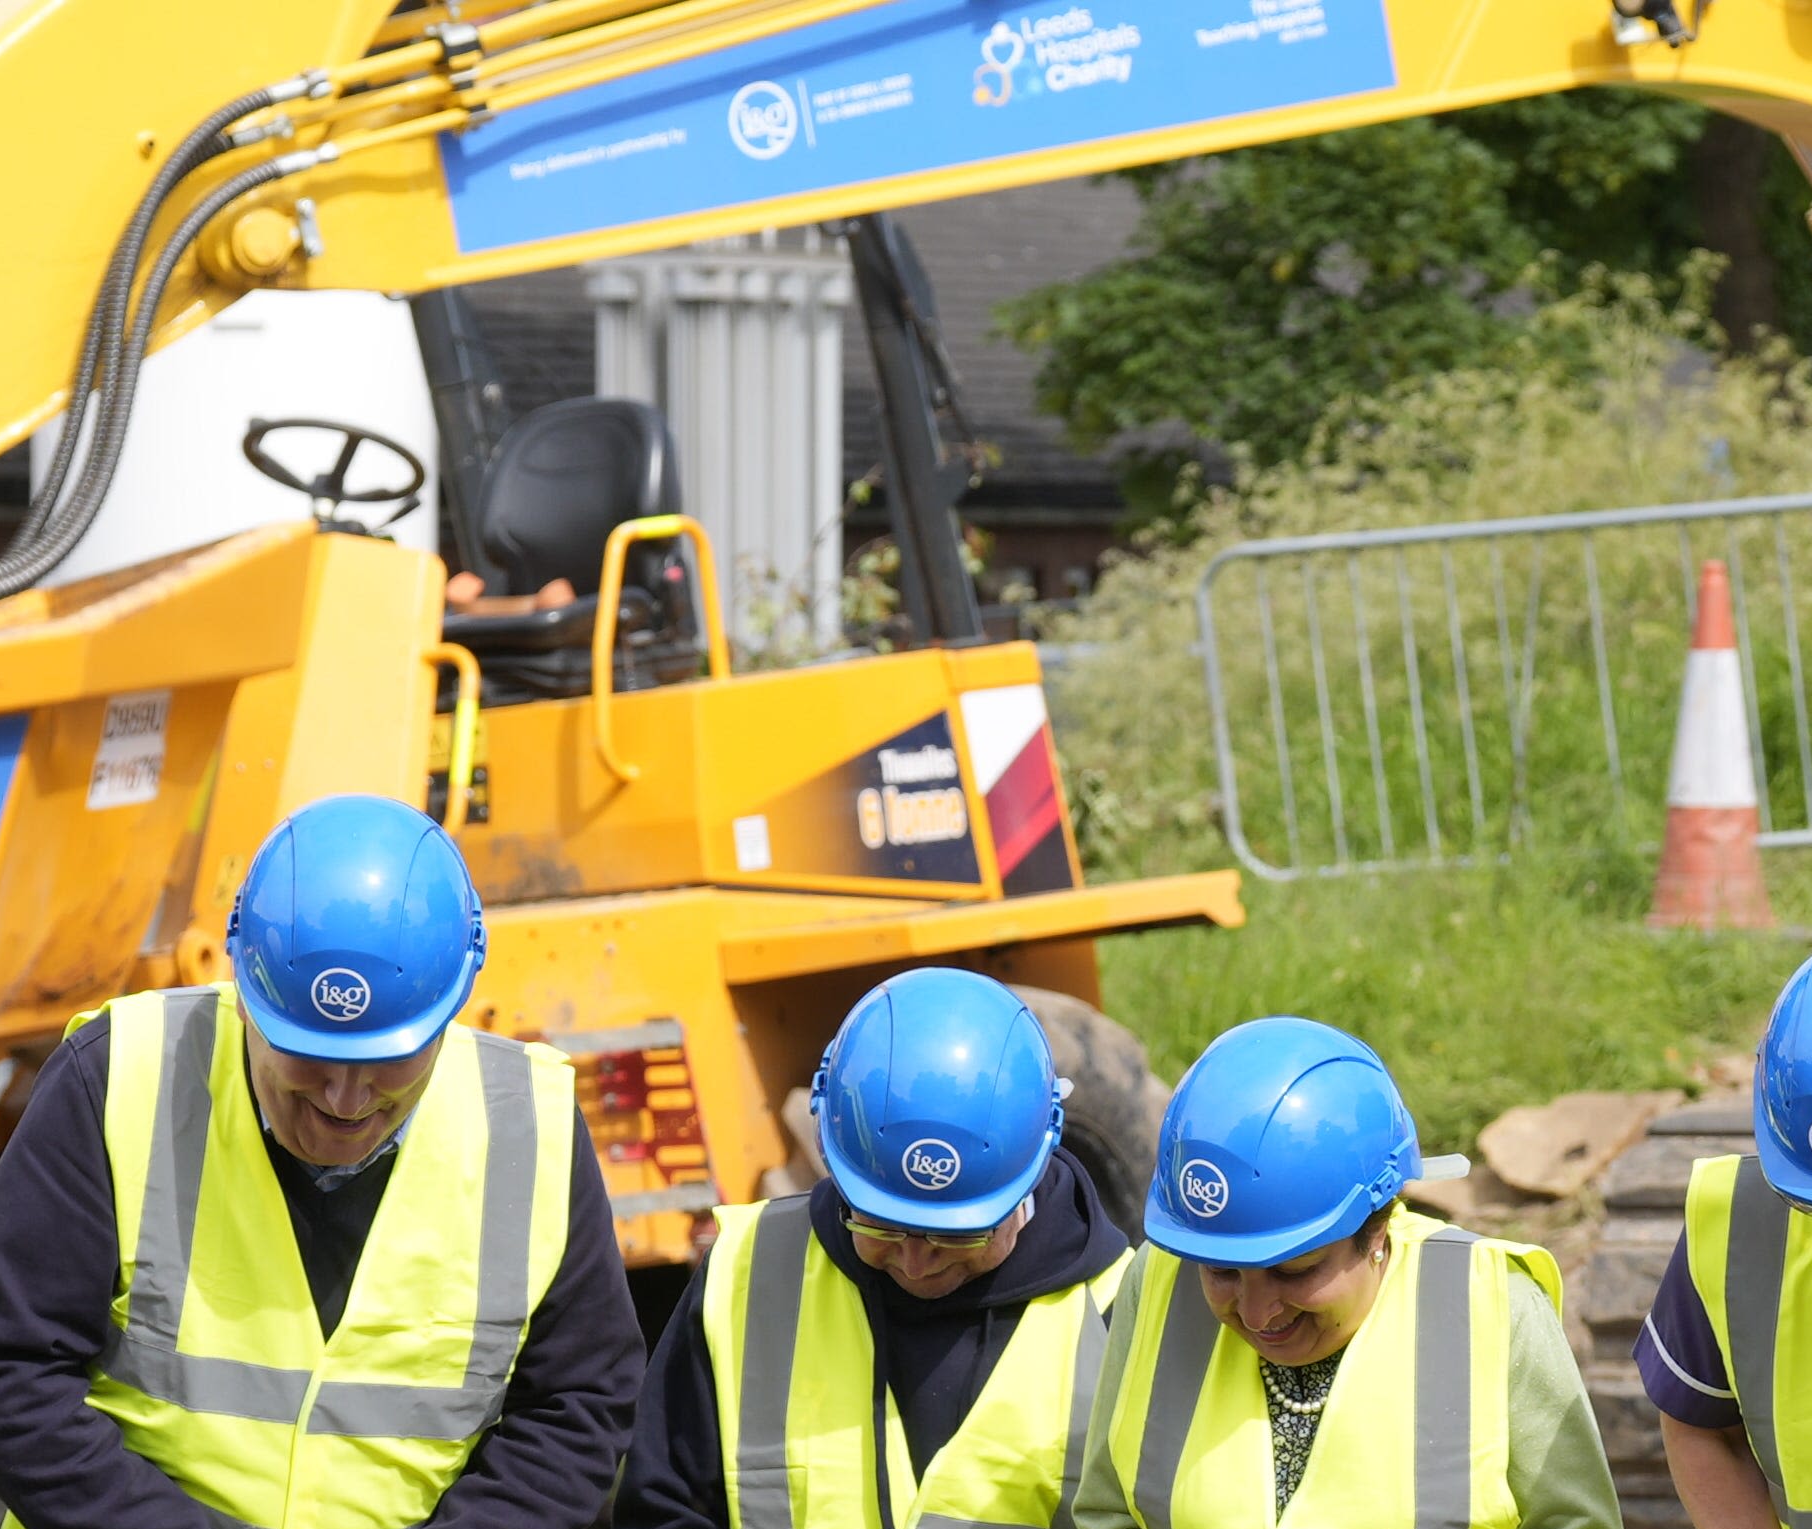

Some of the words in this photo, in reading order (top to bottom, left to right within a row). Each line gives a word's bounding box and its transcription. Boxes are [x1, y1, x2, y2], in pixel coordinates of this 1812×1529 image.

[1021, 8, 1092, 43] Leeds
[1034, 24, 1141, 67] Hospitals
[1045, 54, 1132, 92] Charity
[319, 978, 366, 1018] i&g
[909, 1148, 956, 1188] i&g
[1184, 1169, 1224, 1214] i&g
